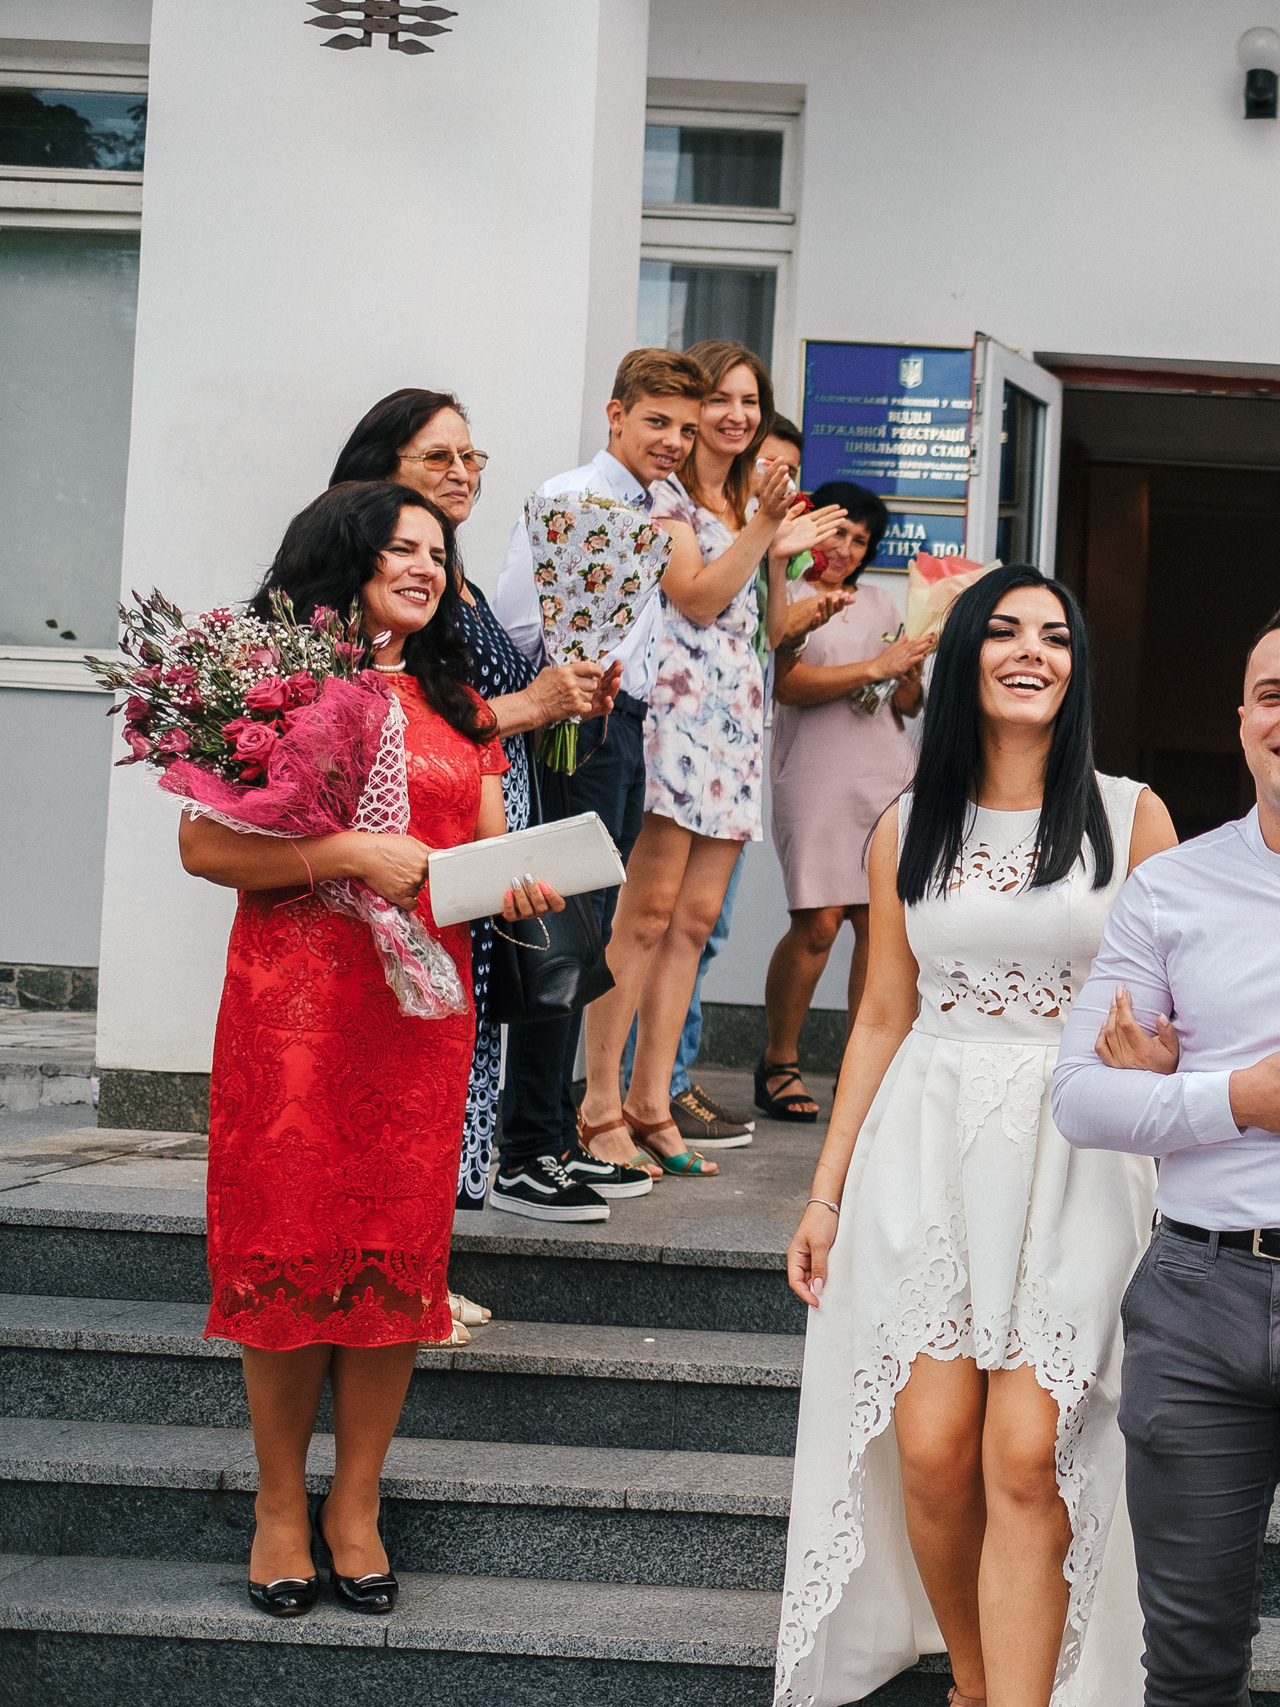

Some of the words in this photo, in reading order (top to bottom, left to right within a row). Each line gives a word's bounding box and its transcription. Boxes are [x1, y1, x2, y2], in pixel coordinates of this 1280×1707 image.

[888, 411, 932, 424] ВІДДІЛ
[811, 424, 887, 438] ДЕРЖАВНОЇ
[891, 426, 967, 442] РЕЄСТРАЦІЇ
[845, 441, 927, 457] ЦИВІЛЬНОГО
